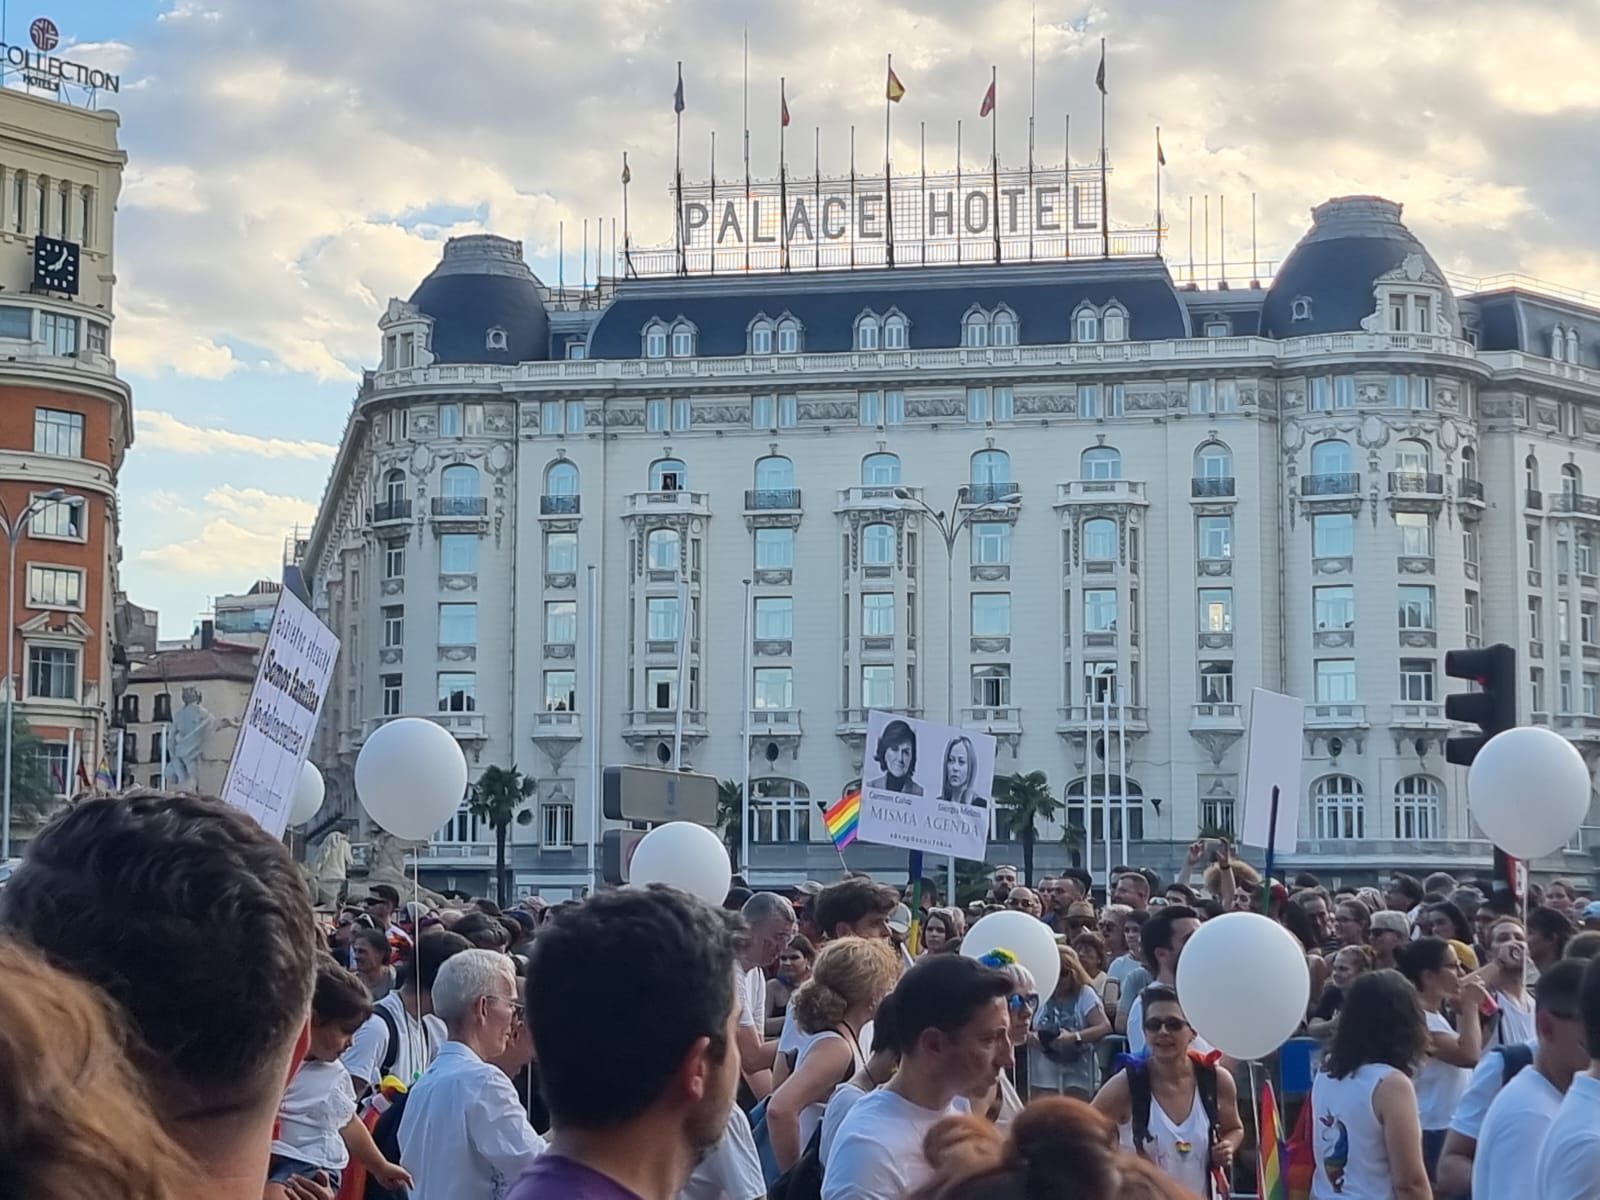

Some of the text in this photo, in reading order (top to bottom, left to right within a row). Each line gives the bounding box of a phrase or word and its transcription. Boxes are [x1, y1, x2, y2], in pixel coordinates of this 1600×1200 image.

[23, 74, 60, 92] HOTELS
[684, 185, 1098, 246] PALACE HOTEL
[263, 648, 292, 695] Somos
[871, 805, 979, 837] MISMA AGENDA
